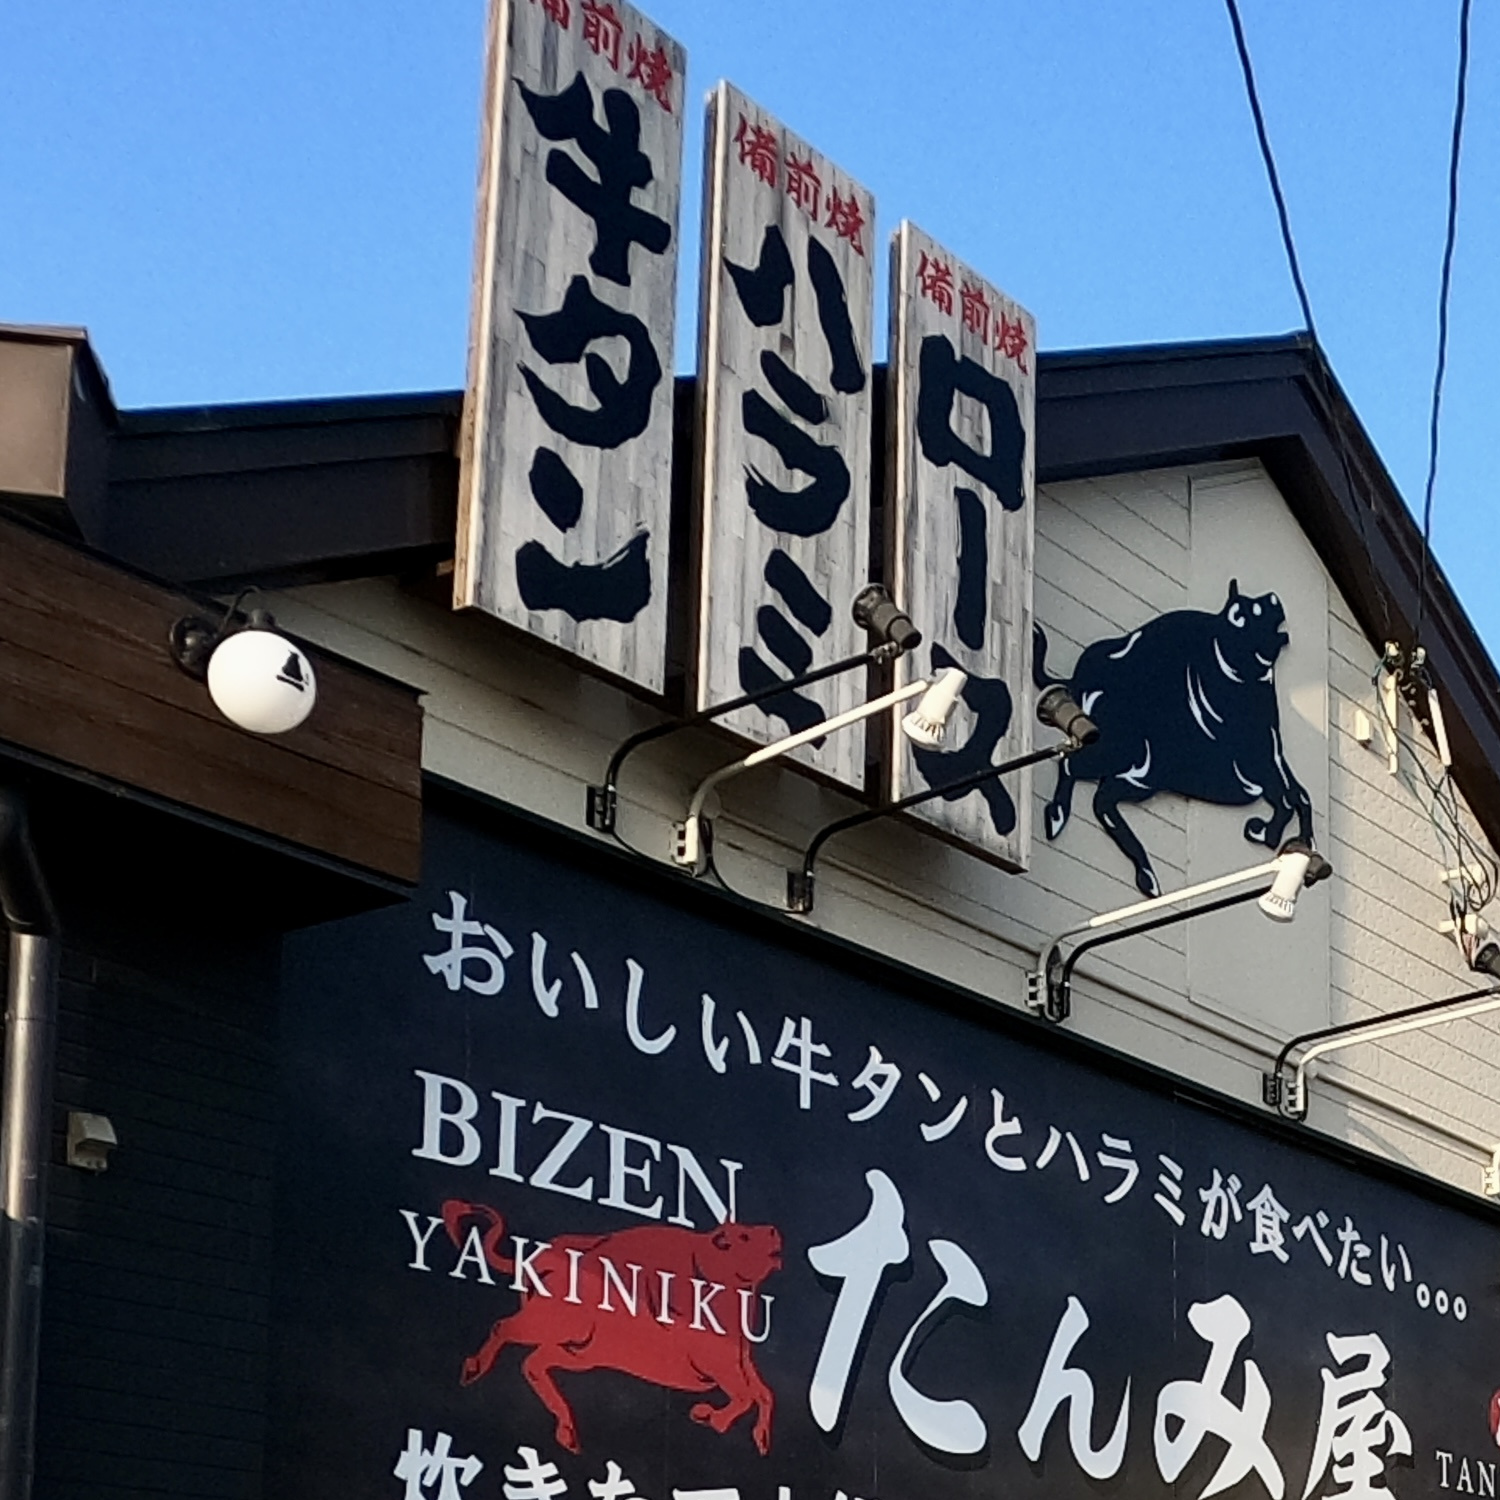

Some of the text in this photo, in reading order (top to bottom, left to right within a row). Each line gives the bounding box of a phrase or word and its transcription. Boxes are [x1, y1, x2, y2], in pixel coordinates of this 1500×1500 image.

[734, 112, 866, 256] 備前焼
[917, 251, 1029, 377] 備前焼
[723, 225, 865, 749] ハラミ
[912, 334, 1027, 837] ロース
[412, 1069, 743, 1231] BIZEN
[399, 1208, 775, 1343] YAKINIKU
